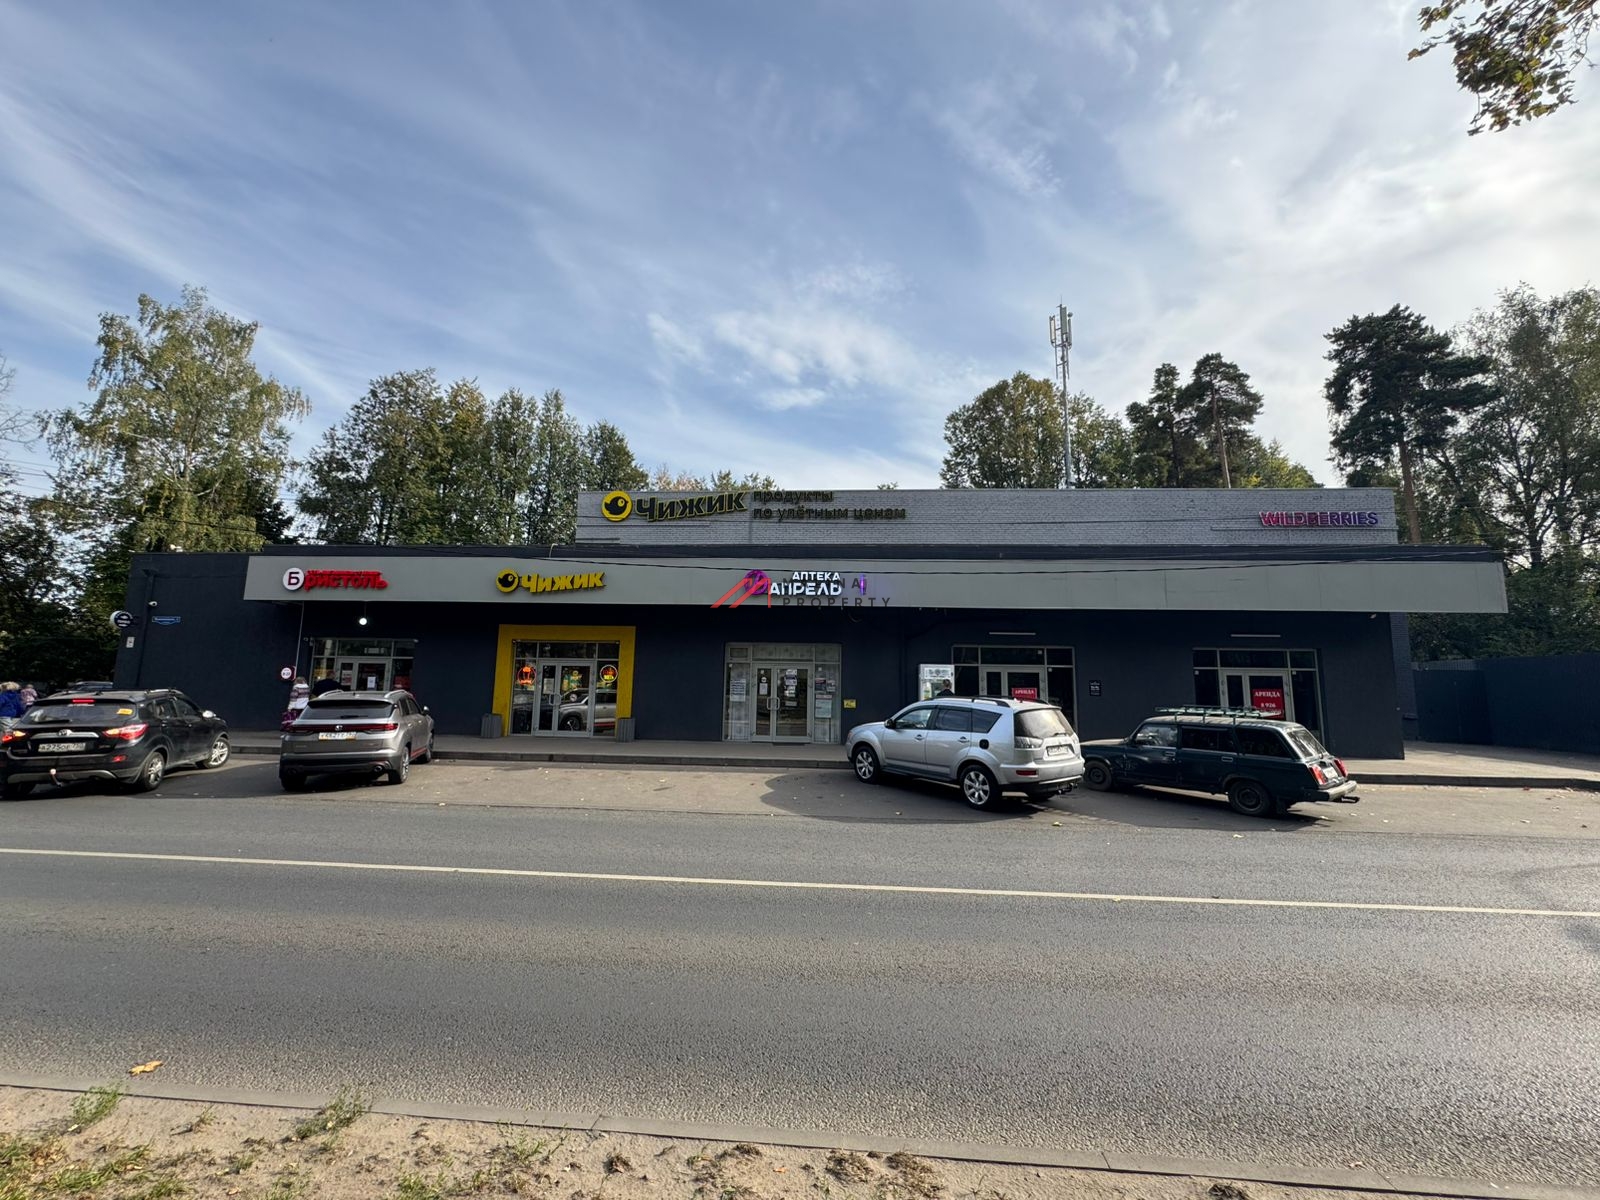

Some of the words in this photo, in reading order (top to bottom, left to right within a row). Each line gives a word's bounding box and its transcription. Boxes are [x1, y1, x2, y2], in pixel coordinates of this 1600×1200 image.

[753, 491, 834, 504] продукты
[753, 508, 773, 519] по
[853, 508, 907, 520] ценам
[1259, 511, 1379, 527] WILDBERRIES
[792, 571, 840, 581] АПТЕКА
[769, 582, 842, 596] АПРЕЛЬ
